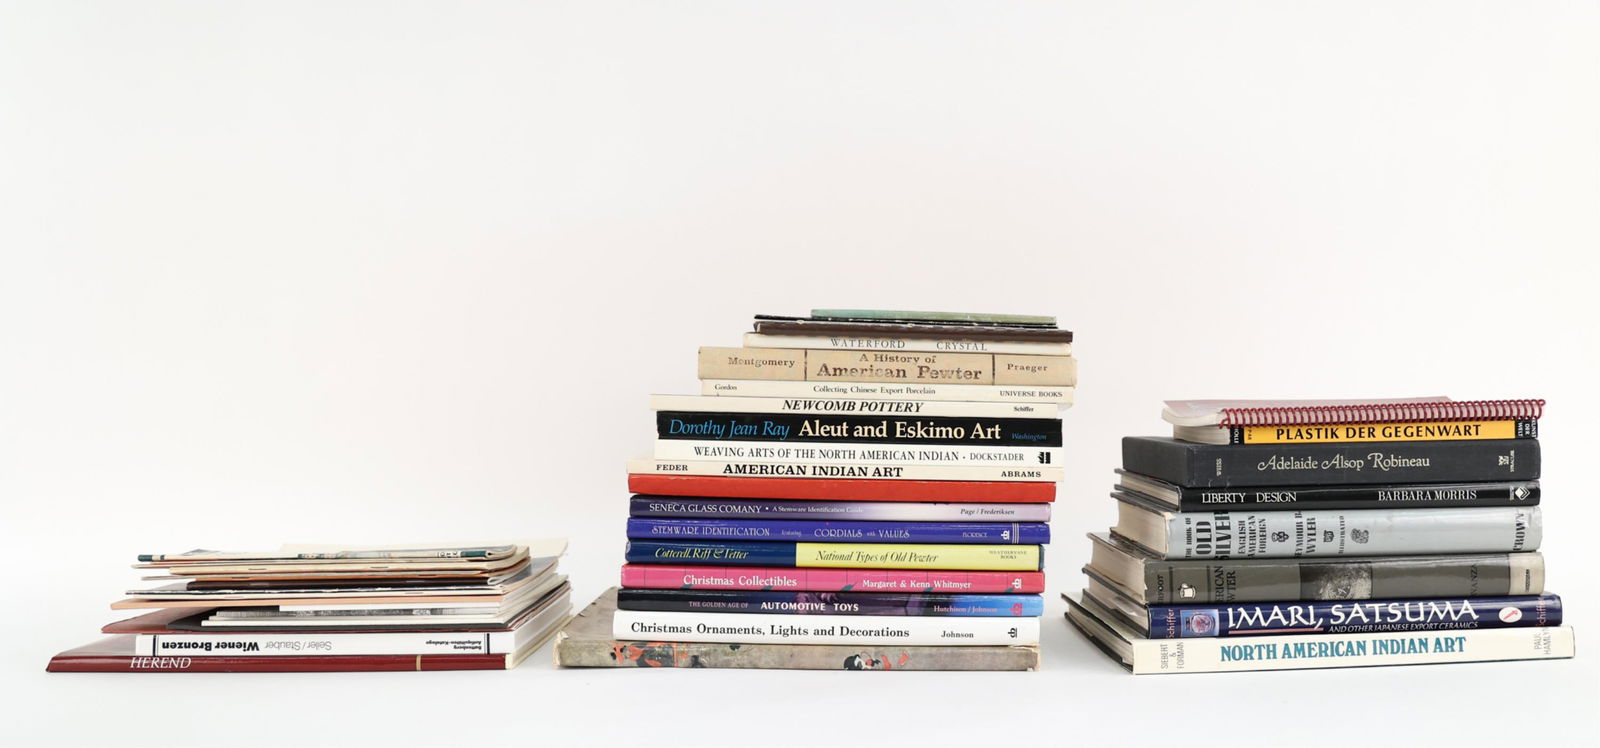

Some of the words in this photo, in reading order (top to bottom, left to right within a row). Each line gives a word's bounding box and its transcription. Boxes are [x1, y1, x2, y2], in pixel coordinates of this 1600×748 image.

[830, 338, 905, 349] WATERFORD
[936, 342, 988, 351] CRYSTAL
[728, 357, 795, 368] Montgomery
[859, 353, 870, 362] A
[873, 354, 920, 365] History
[925, 355, 937, 364] of
[817, 363, 907, 379] American
[917, 365, 982, 381] Pewter
[1007, 363, 1048, 373] Praeger
[714, 383, 738, 391] Gordon
[813, 385, 848, 394] Collecting
[880, 387, 903, 396] Export
[906, 387, 936, 395] Porcelain
[1000, 390, 1036, 398] UNIVERSE
[782, 399, 856, 412] NEWCOMB
[859, 401, 924, 413] POTTERY
[669, 419, 725, 440] Dorothy
[728, 420, 758, 439] Jean
[762, 420, 790, 440] Ray
[798, 420, 848, 437] Aleut
[853, 421, 887, 438] and
[895, 421, 965, 439] Eskimo
[970, 422, 1001, 440] Art
[1276, 427, 1340, 441] PLASTIK
[1345, 426, 1376, 439] DER
[1382, 424, 1482, 438] GEGENWART
[1011, 433, 1047, 442] Washington
[694, 446, 744, 457] WEAVING
[748, 448, 774, 458] ARTS
[778, 448, 791, 458] OF
[794, 448, 816, 459] THE
[819, 449, 856, 459] NORTH
[860, 450, 915, 461] AMERICAN
[919, 451, 959, 461] INDIAN
[970, 453, 1025, 461] DOCKSTADER
[1257, 455, 1318, 471] Adelaide
[1321, 453, 1364, 471] Alsop
[1367, 452, 1430, 470] Robineau
[723, 464, 806, 476] AMERICAN
[812, 466, 868, 476] INDIAN
[872, 467, 903, 477] ART
[1001, 470, 1042, 478] ABRAMS
[1202, 492, 1246, 503] LIBERTY
[1256, 491, 1297, 503] DESIGN
[1378, 490, 1432, 501] BARBARA
[1434, 490, 1477, 500] MORRIS
[649, 503, 686, 512] SENECA
[688, 504, 717, 513] GLASS
[719, 505, 762, 514] COMANY
[960, 508, 975, 516] Page
[652, 526, 699, 536] STEMWARE
[702, 527, 770, 537] IDENTIFICATION
[814, 529, 863, 538] CORDIALS
[879, 529, 910, 539] VALUES
[1196, 521, 1213, 555] OLD
[1238, 520, 1246, 555] ENGLISH
[1248, 515, 1256, 559] AMERICAN
[1258, 518, 1267, 553] FOREIGN
[1294, 521, 1303, 557] EYMOUR
[1306, 517, 1316, 554] WYLER
[692, 547, 711, 559] Riff
[713, 548, 724, 558] &
[816, 550, 852, 562] National
[856, 551, 878, 563] Types
[880, 552, 888, 562] of
[890, 552, 906, 562] Old
[908, 552, 939, 563] Pewter
[683, 574, 734, 586] Christmas
[738, 575, 798, 587] Collectibles
[862, 579, 897, 589] Margaret
[900, 580, 907, 588] &
[910, 580, 930, 588] Kenn
[933, 580, 972, 590] Whitmyer
[761, 601, 826, 611] AUTOMOTIVE
[834, 603, 859, 612] TOYS
[933, 605, 967, 613] Hutchison
[972, 606, 998, 614] Johnson
[1227, 605, 1324, 630] IMARI,
[1330, 600, 1479, 624] SATSUMA
[631, 622, 692, 634] Christmas
[696, 623, 766, 636] Ornaments,
[770, 624, 809, 637] Lights
[813, 626, 835, 637] and
[839, 626, 910, 638] Decorations
[1331, 623, 1347, 633] AND
[1348, 622, 1373, 633] OTHER
[1373, 622, 1411, 632] JAPANESE
[1410, 622, 1439, 630] EXPORT
[1439, 621, 1479, 630] CERAMICS
[941, 630, 974, 639] Johnson
[1534, 632, 1542, 650] PAUL
[162, 640, 211, 651] Bronzen
[214, 641, 259, 652] Wiener
[264, 640, 301, 650] Stauber
[308, 641, 332, 651] Seiler
[1220, 645, 1277, 662] NORTH
[1282, 641, 1366, 658] AMERICAN
[1373, 638, 1429, 655] INDIAN
[1433, 637, 1467, 653] ART
[1160, 644, 1168, 669] SIEBERT
[1176, 642, 1184, 669] FORMAN
[129, 656, 192, 669] HEREND
